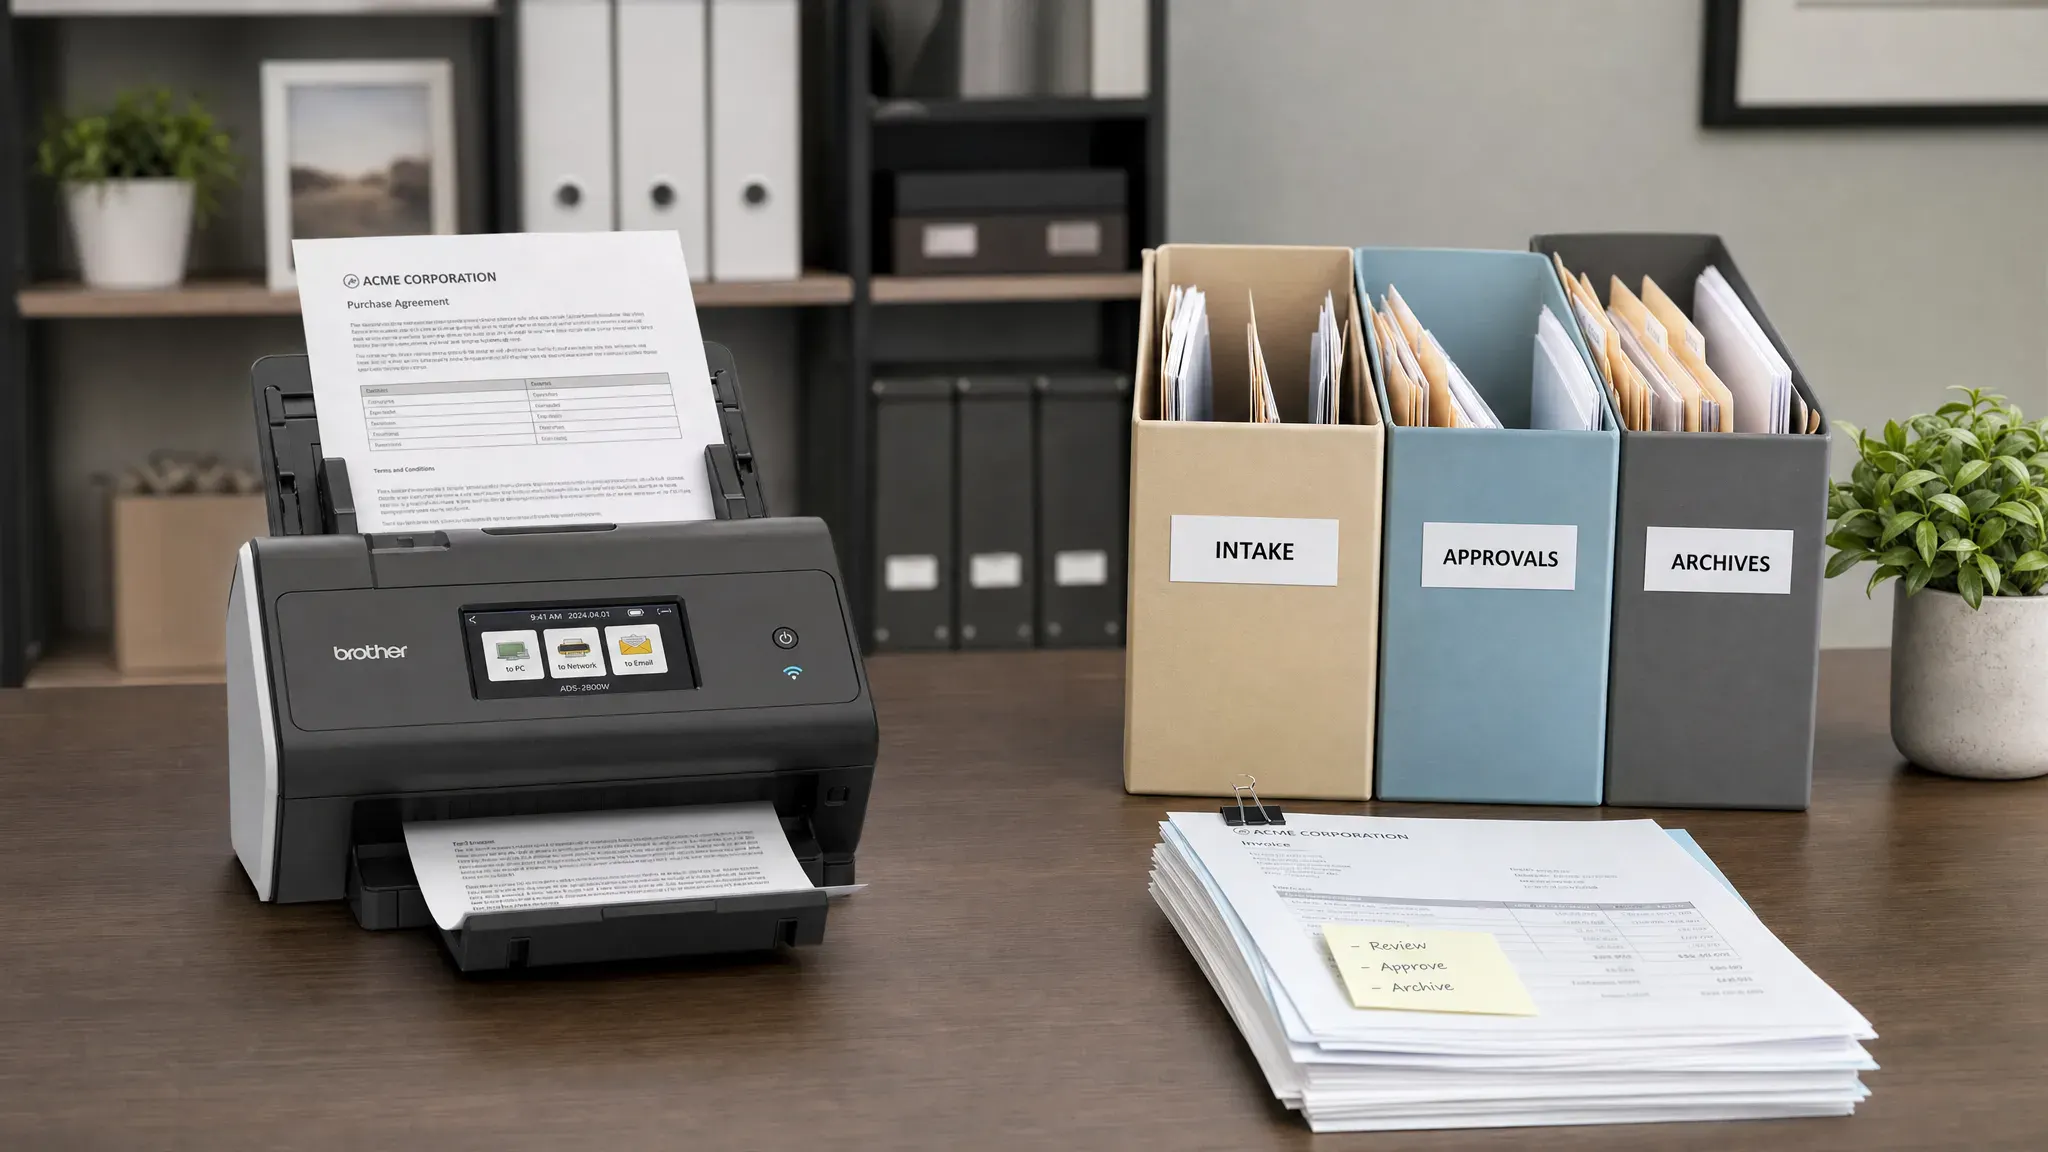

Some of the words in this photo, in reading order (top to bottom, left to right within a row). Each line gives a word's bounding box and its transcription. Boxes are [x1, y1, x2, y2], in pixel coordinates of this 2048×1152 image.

[363, 274, 400, 286] ACME
[404, 272, 497, 285] CORPORATION
[347, 300, 392, 309] Purchase
[394, 298, 450, 309] Agreement
[404, 465, 436, 473] Conditions
[1215, 541, 1295, 560] INTAKE
[1443, 549, 1559, 567] APPROVALS
[1671, 553, 1770, 572] ARCHIVES
[530, 613, 547, 621] 9:41
[567, 610, 610, 619] 2024.04.01
[333, 644, 408, 660] brother
[557, 663, 566, 671] to
[567, 661, 598, 670] Network
[633, 659, 654, 667] Email
[505, 665, 514, 673] to
[514, 664, 526, 672] PC
[560, 683, 610, 692] ADS-2800W
[1300, 830, 1409, 840] CORPORATION
[1242, 840, 1291, 848] Invoice
[1369, 941, 1427, 951] Review
[1381, 962, 1448, 975] Approve
[1392, 982, 1455, 992] Archive
